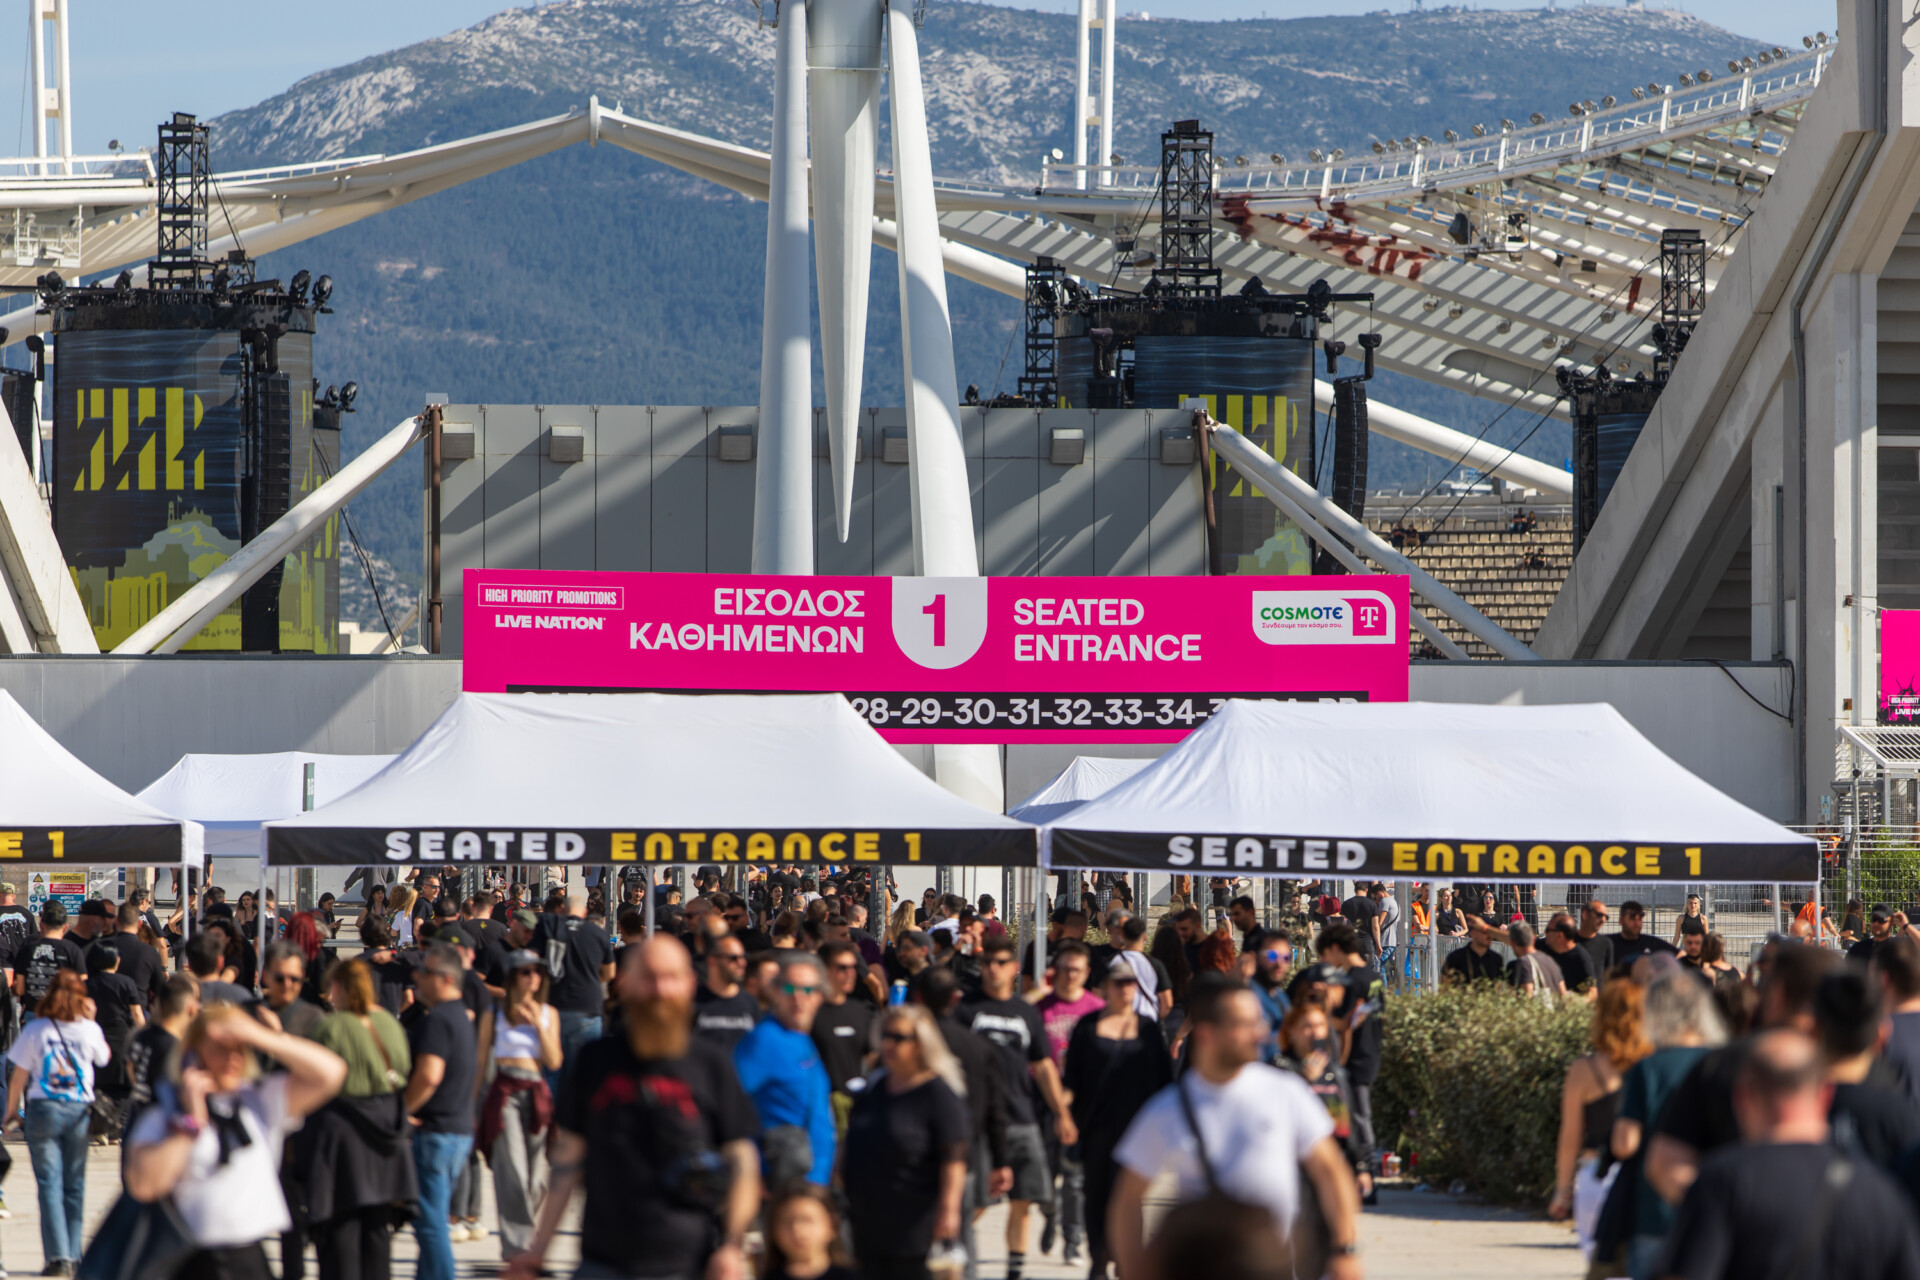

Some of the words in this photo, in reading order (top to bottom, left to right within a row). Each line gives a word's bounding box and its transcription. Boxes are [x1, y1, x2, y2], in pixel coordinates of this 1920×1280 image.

[485, 588, 508, 602] HIGH
[511, 589, 553, 603] PRIORITY
[556, 590, 617, 605] PROMOTIONS
[714, 588, 865, 617] ΕΙΣΟΔΟΣ
[495, 614, 532, 628] LIVE
[535, 615, 603, 630] NATION
[922, 594, 945, 647] 1
[1013, 598, 1144, 626] SEATED
[1260, 606, 1343, 620] COSMOTE
[630, 622, 864, 653] ΚΑΘΗΜΕΝΩΝ
[1014, 633, 1202, 662] ENTRANCE
[48, 831, 65, 858] 1
[385, 831, 586, 861] SEATED
[611, 832, 880, 861] ENTRANCE
[904, 832, 921, 861] 1
[1167, 836, 1367, 870] SEATED
[1392, 842, 1661, 875] ENTRANCE
[1685, 847, 1701, 876] 1
